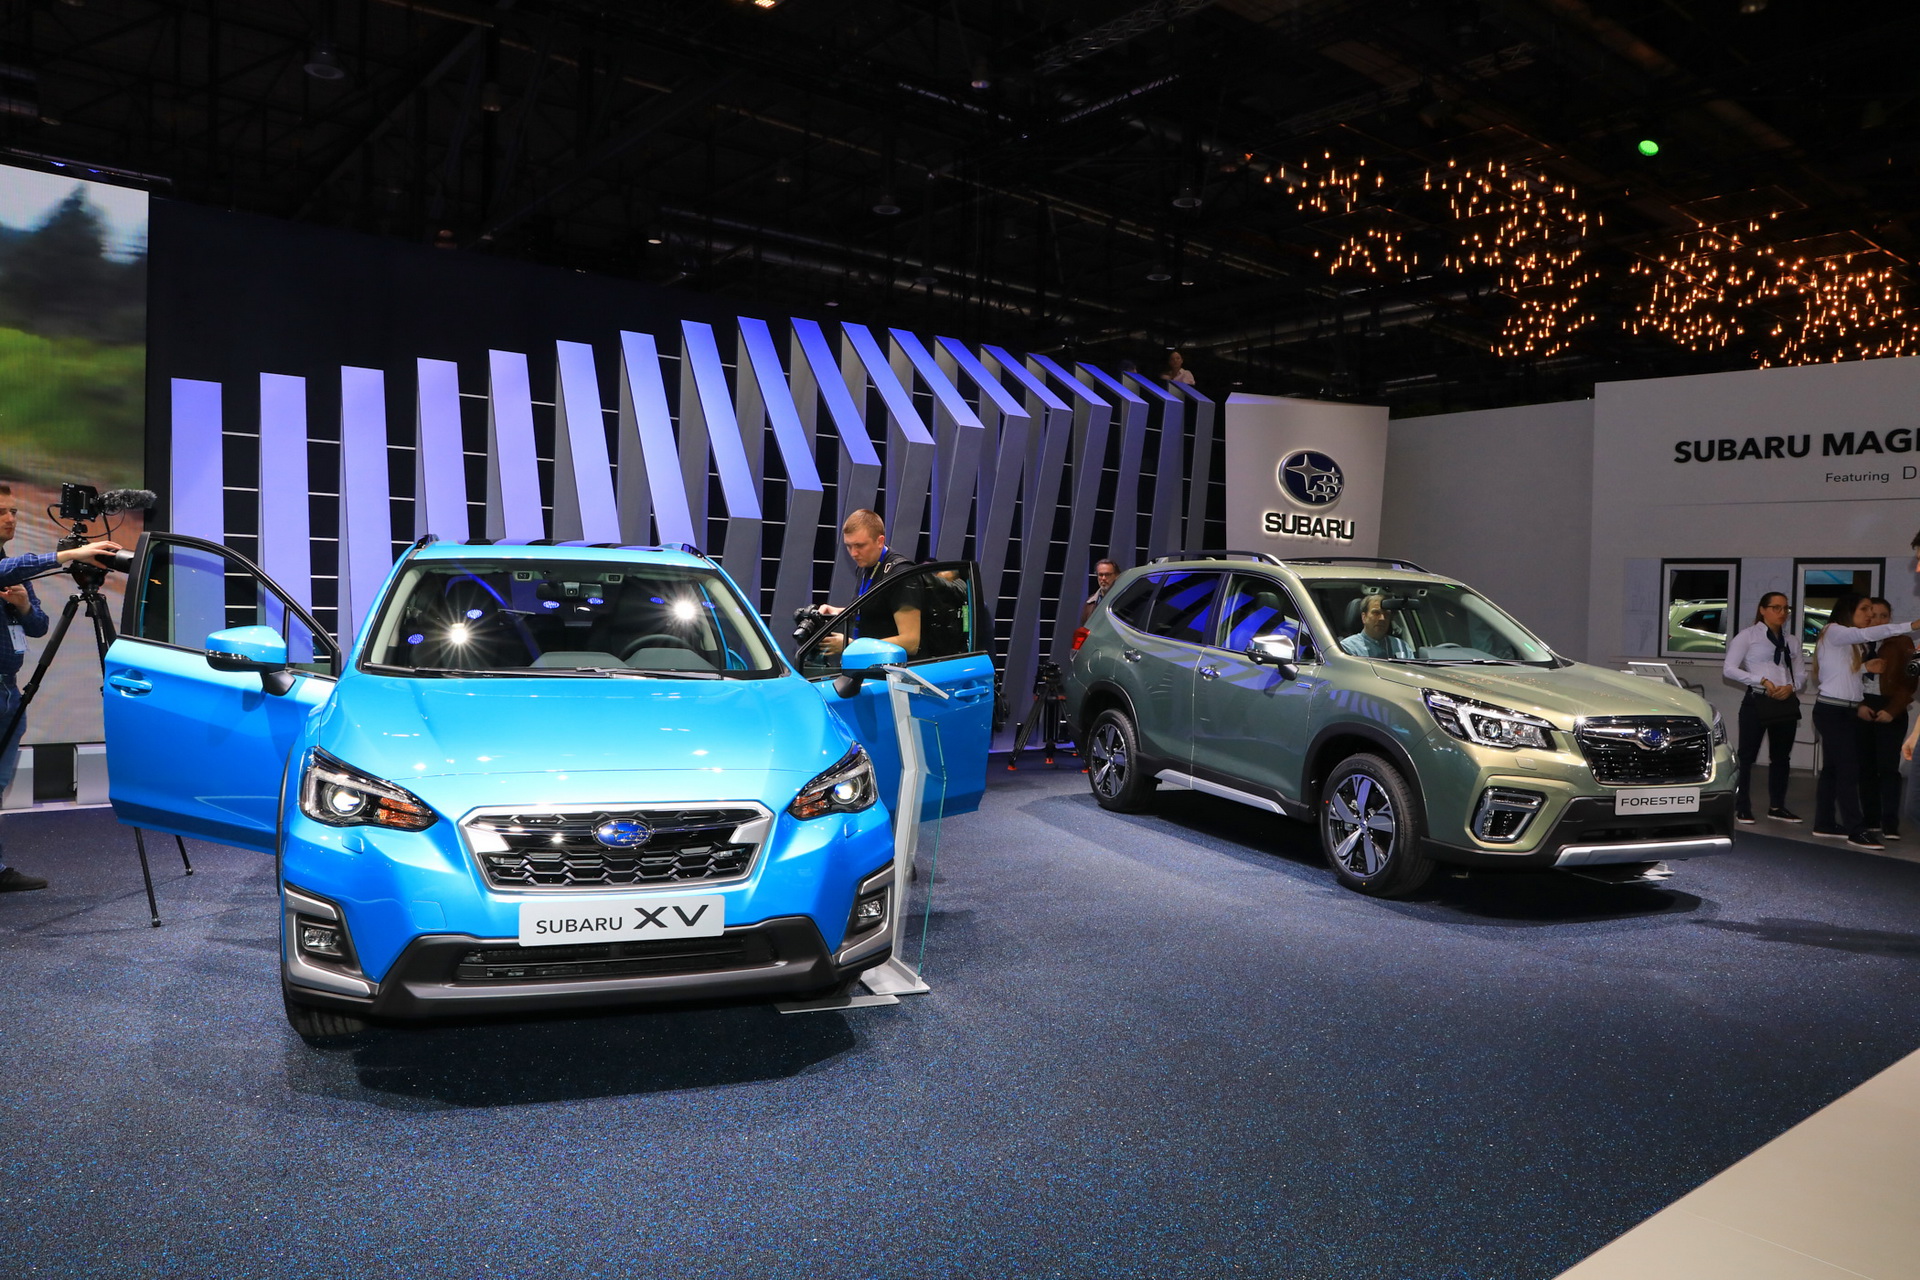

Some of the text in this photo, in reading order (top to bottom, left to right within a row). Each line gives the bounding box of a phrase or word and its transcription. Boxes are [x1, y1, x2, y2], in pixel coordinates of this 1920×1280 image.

[1673, 433, 1811, 464] SUBARU
[1825, 471, 1890, 483] Featuring
[1265, 512, 1356, 540] SUBARU
[1620, 795, 1695, 807] FORESTER
[536, 904, 709, 935] SUBARU XV
